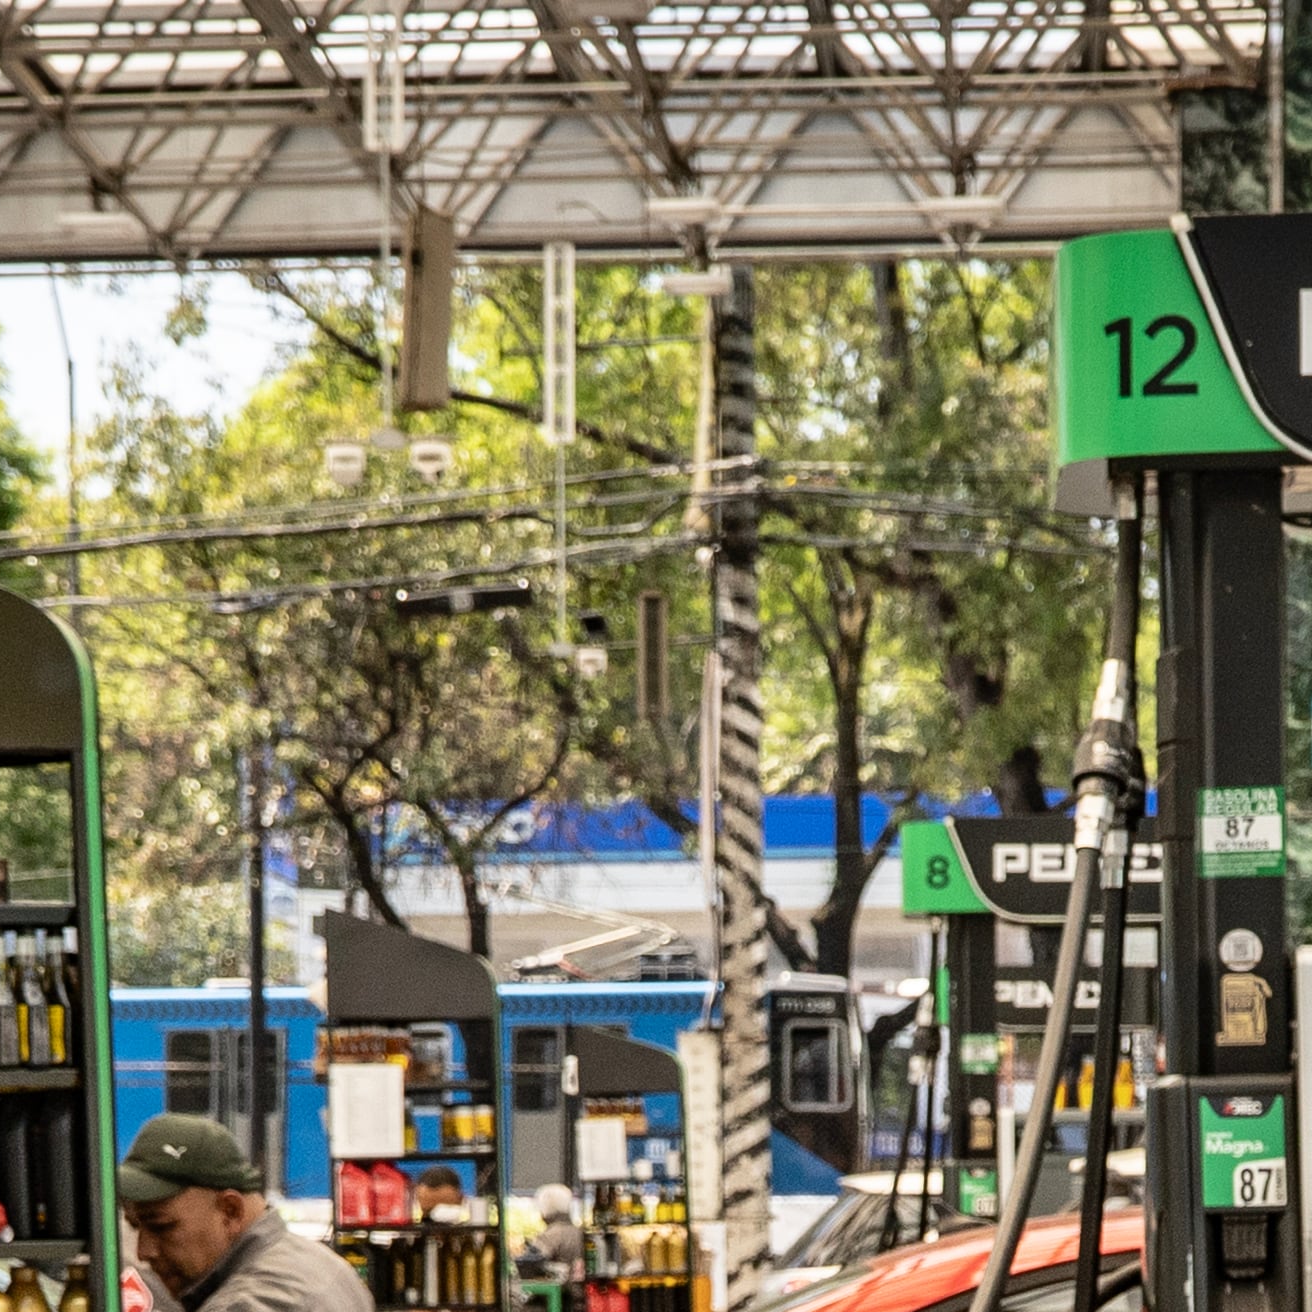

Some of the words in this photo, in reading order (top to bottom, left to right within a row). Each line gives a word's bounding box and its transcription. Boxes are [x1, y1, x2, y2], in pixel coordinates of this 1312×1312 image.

[1103, 315, 1199, 399] 12
[1203, 787, 1279, 801] GASOLINA
[1203, 800, 1279, 815] REGULAR
[1225, 818, 1254, 838] 87
[926, 854, 950, 889] 8
[1206, 1137, 1264, 1158] Magna
[1240, 1168, 1272, 1202] 87
